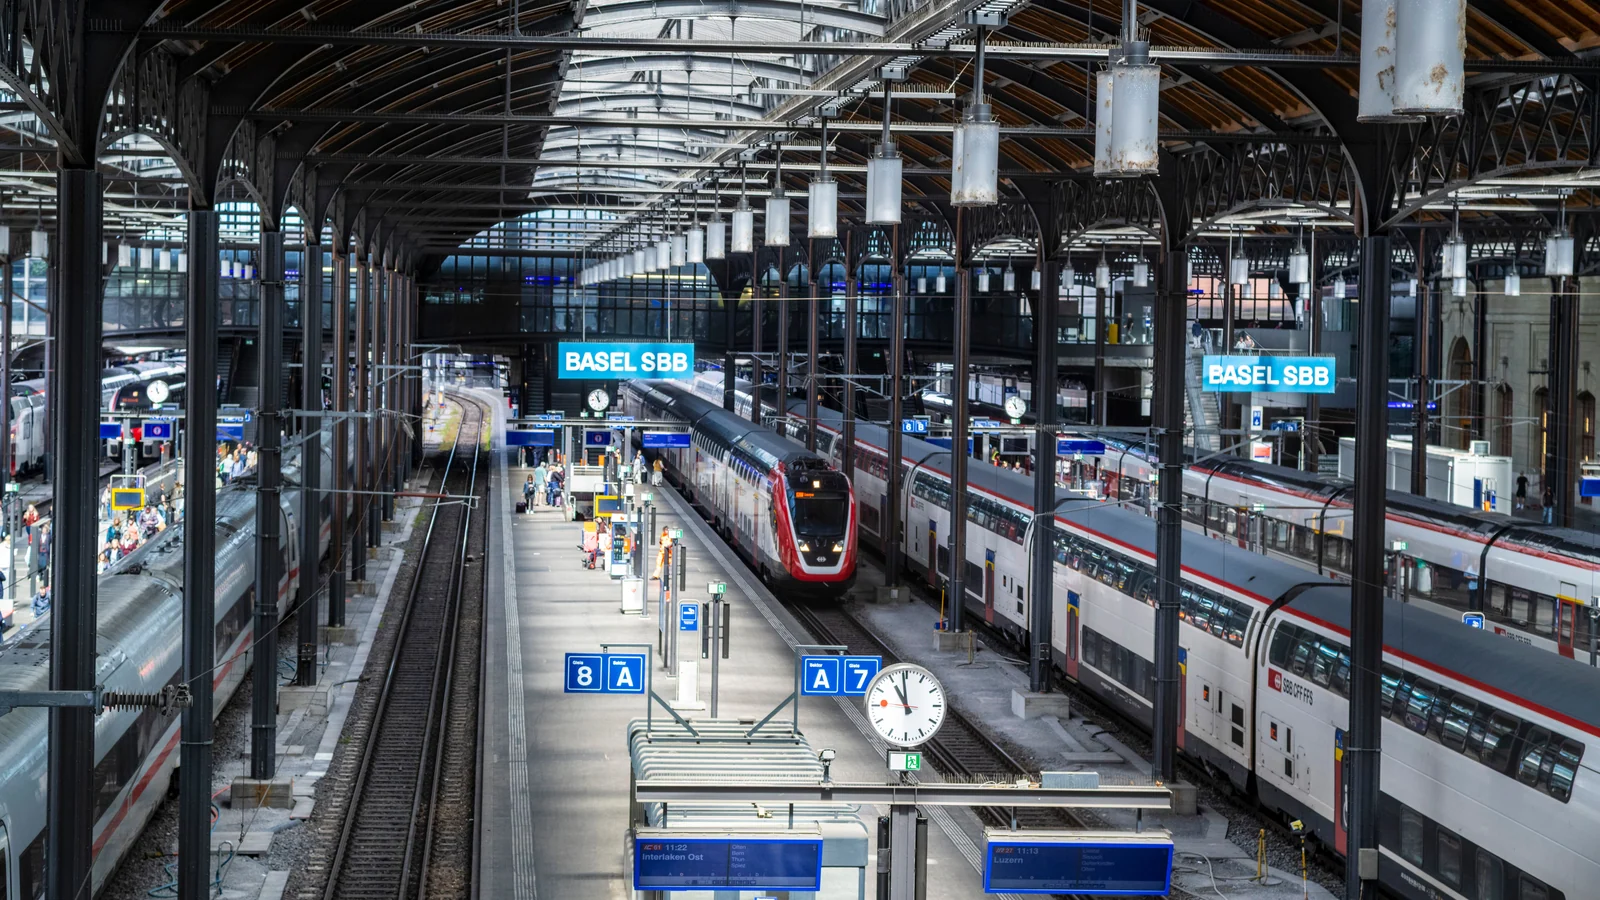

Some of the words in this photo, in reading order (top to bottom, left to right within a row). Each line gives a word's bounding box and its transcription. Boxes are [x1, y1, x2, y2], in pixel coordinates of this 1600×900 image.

[565, 352, 637, 372] BASEL
[641, 352, 688, 372] SBB
[1208, 364, 1280, 386] BASEL
[1283, 365, 1329, 386] SBB
[905, 423, 912, 431] 6
[577, 665, 593, 686] 8
[616, 666, 634, 687] A
[812, 668, 830, 689] A
[853, 669, 869, 689] 7
[1282, 677, 1293, 696] SBB
[1293, 682, 1303, 701] CFF
[1303, 687, 1314, 706] FFS
[642, 853, 686, 861] Interlaken
[687, 853, 704, 861] Ost
[993, 856, 1024, 864] Luzern
[1017, 847, 1039, 855] 11:13
